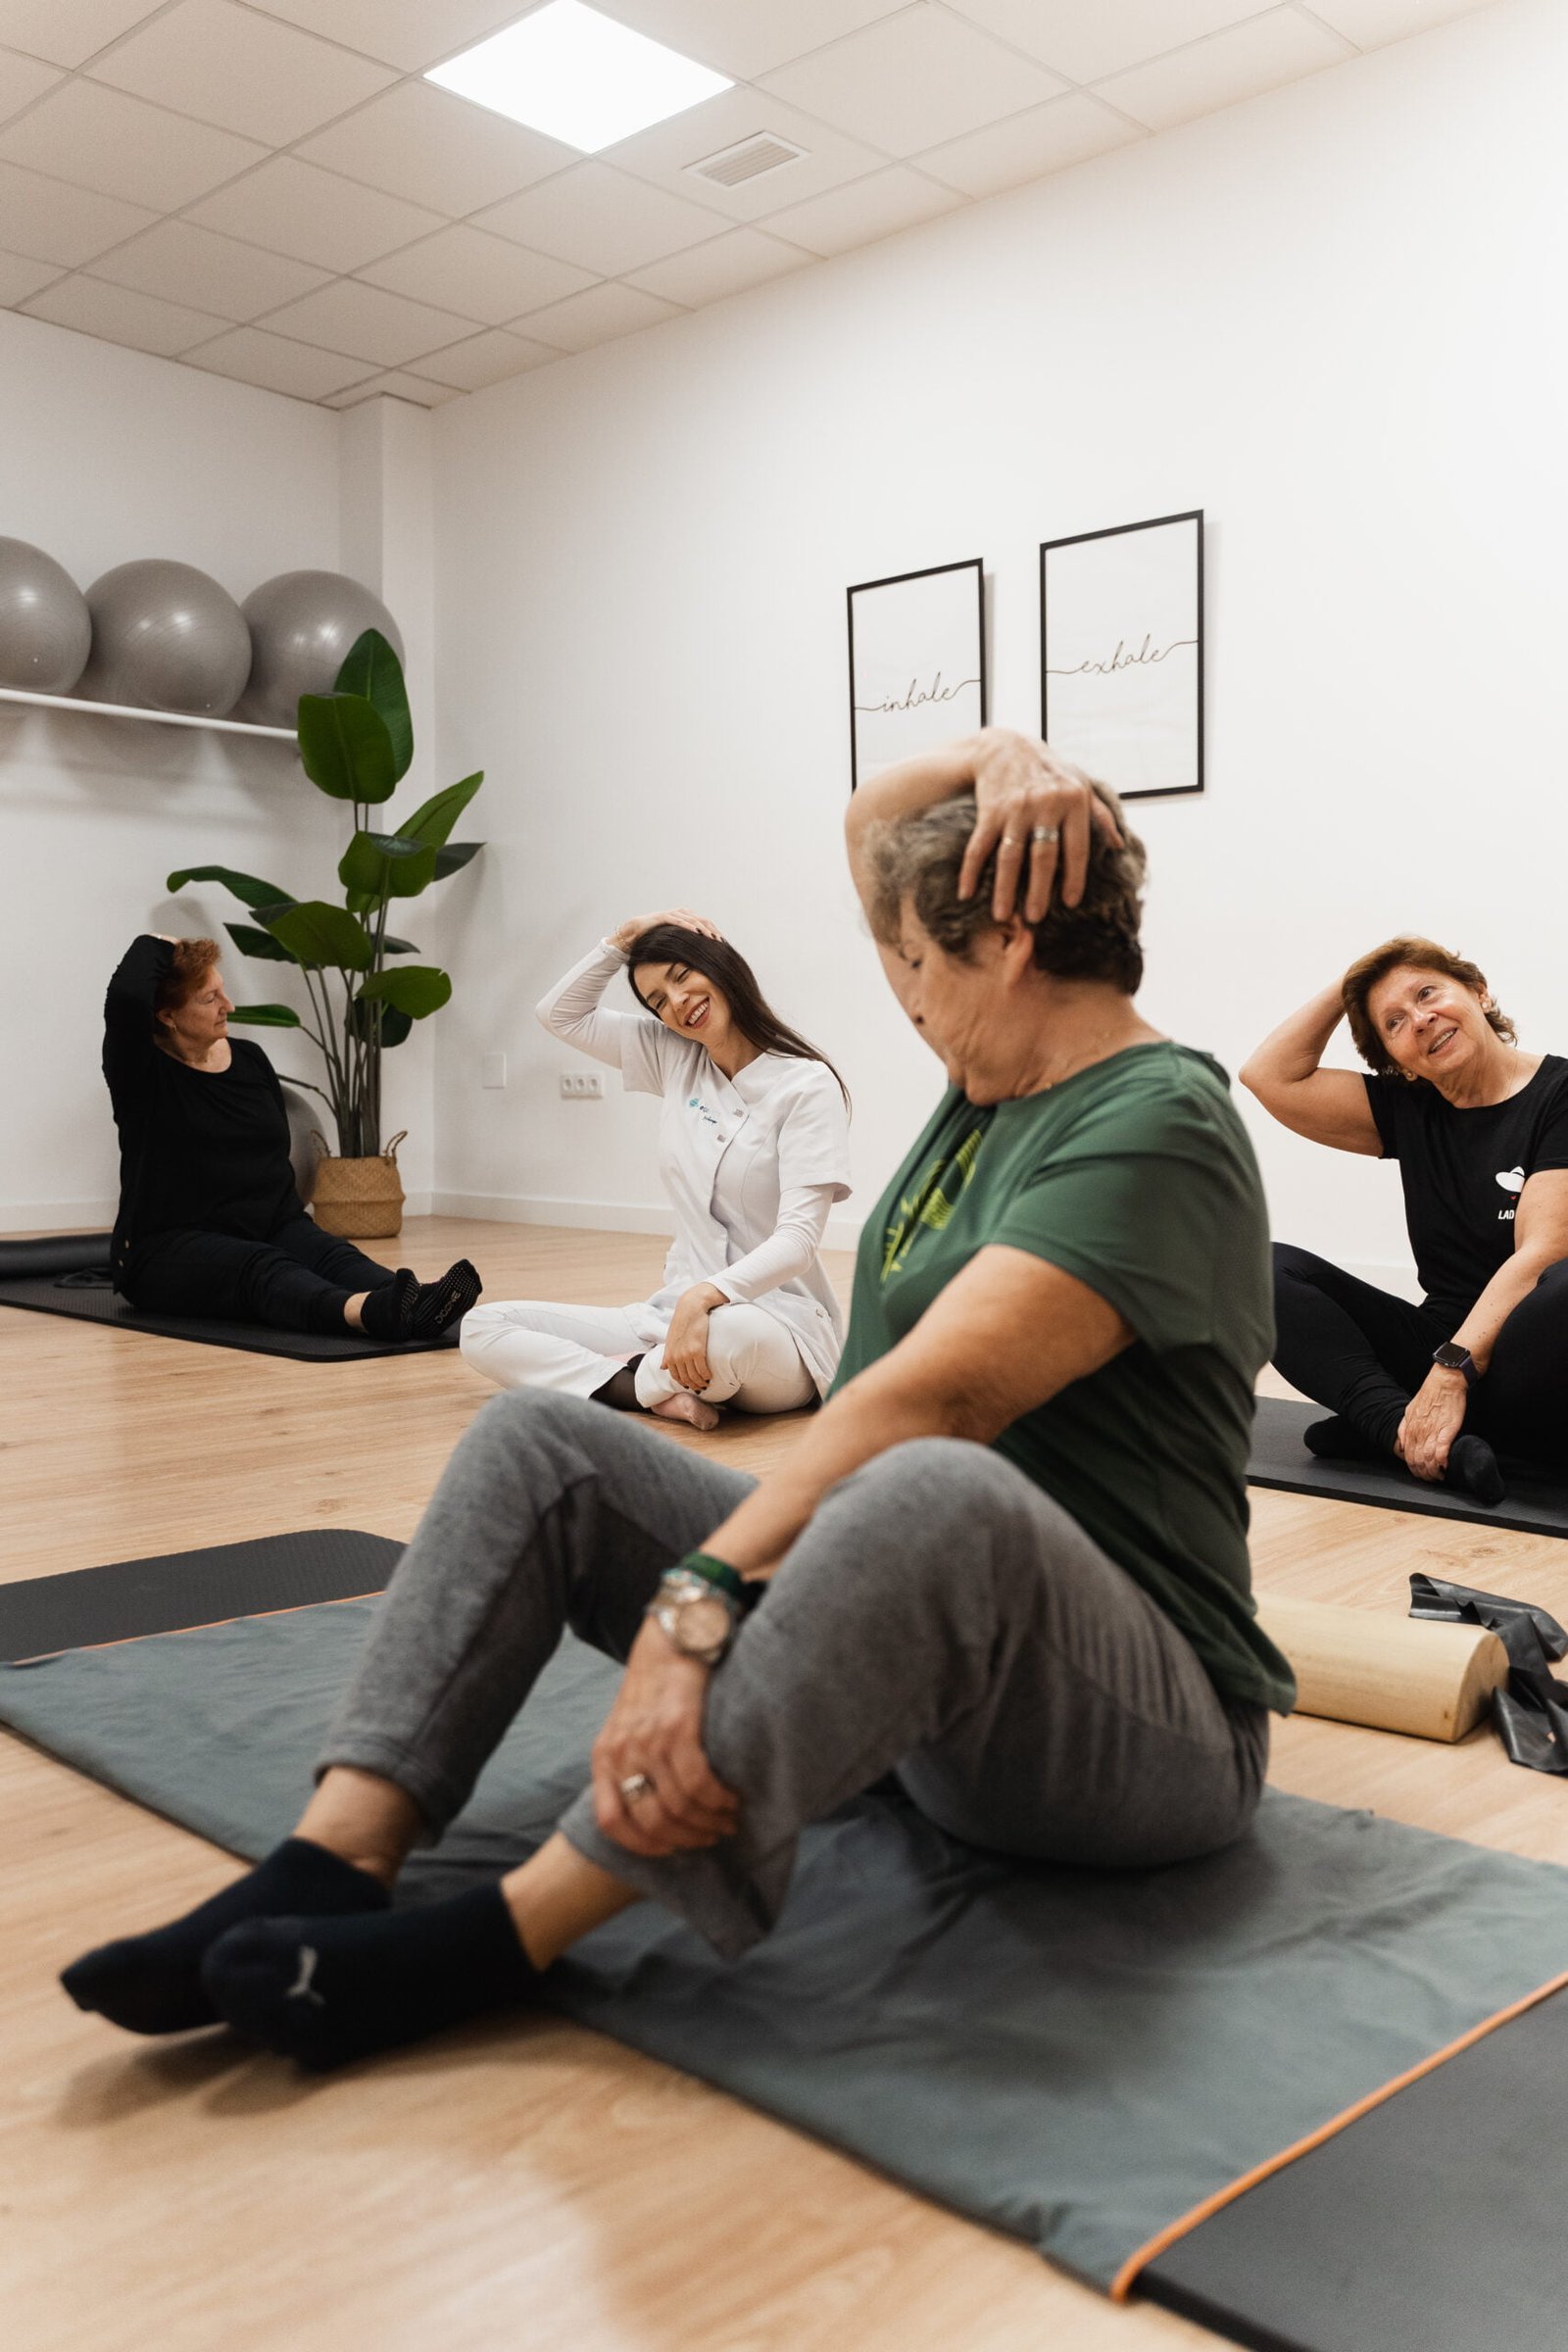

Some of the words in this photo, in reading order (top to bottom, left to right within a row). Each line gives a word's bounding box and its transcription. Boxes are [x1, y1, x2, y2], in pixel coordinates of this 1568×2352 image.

[1069, 633, 1176, 674] exhale
[871, 671, 965, 712] inhale
[1497, 1209, 1515, 1220] LAD
